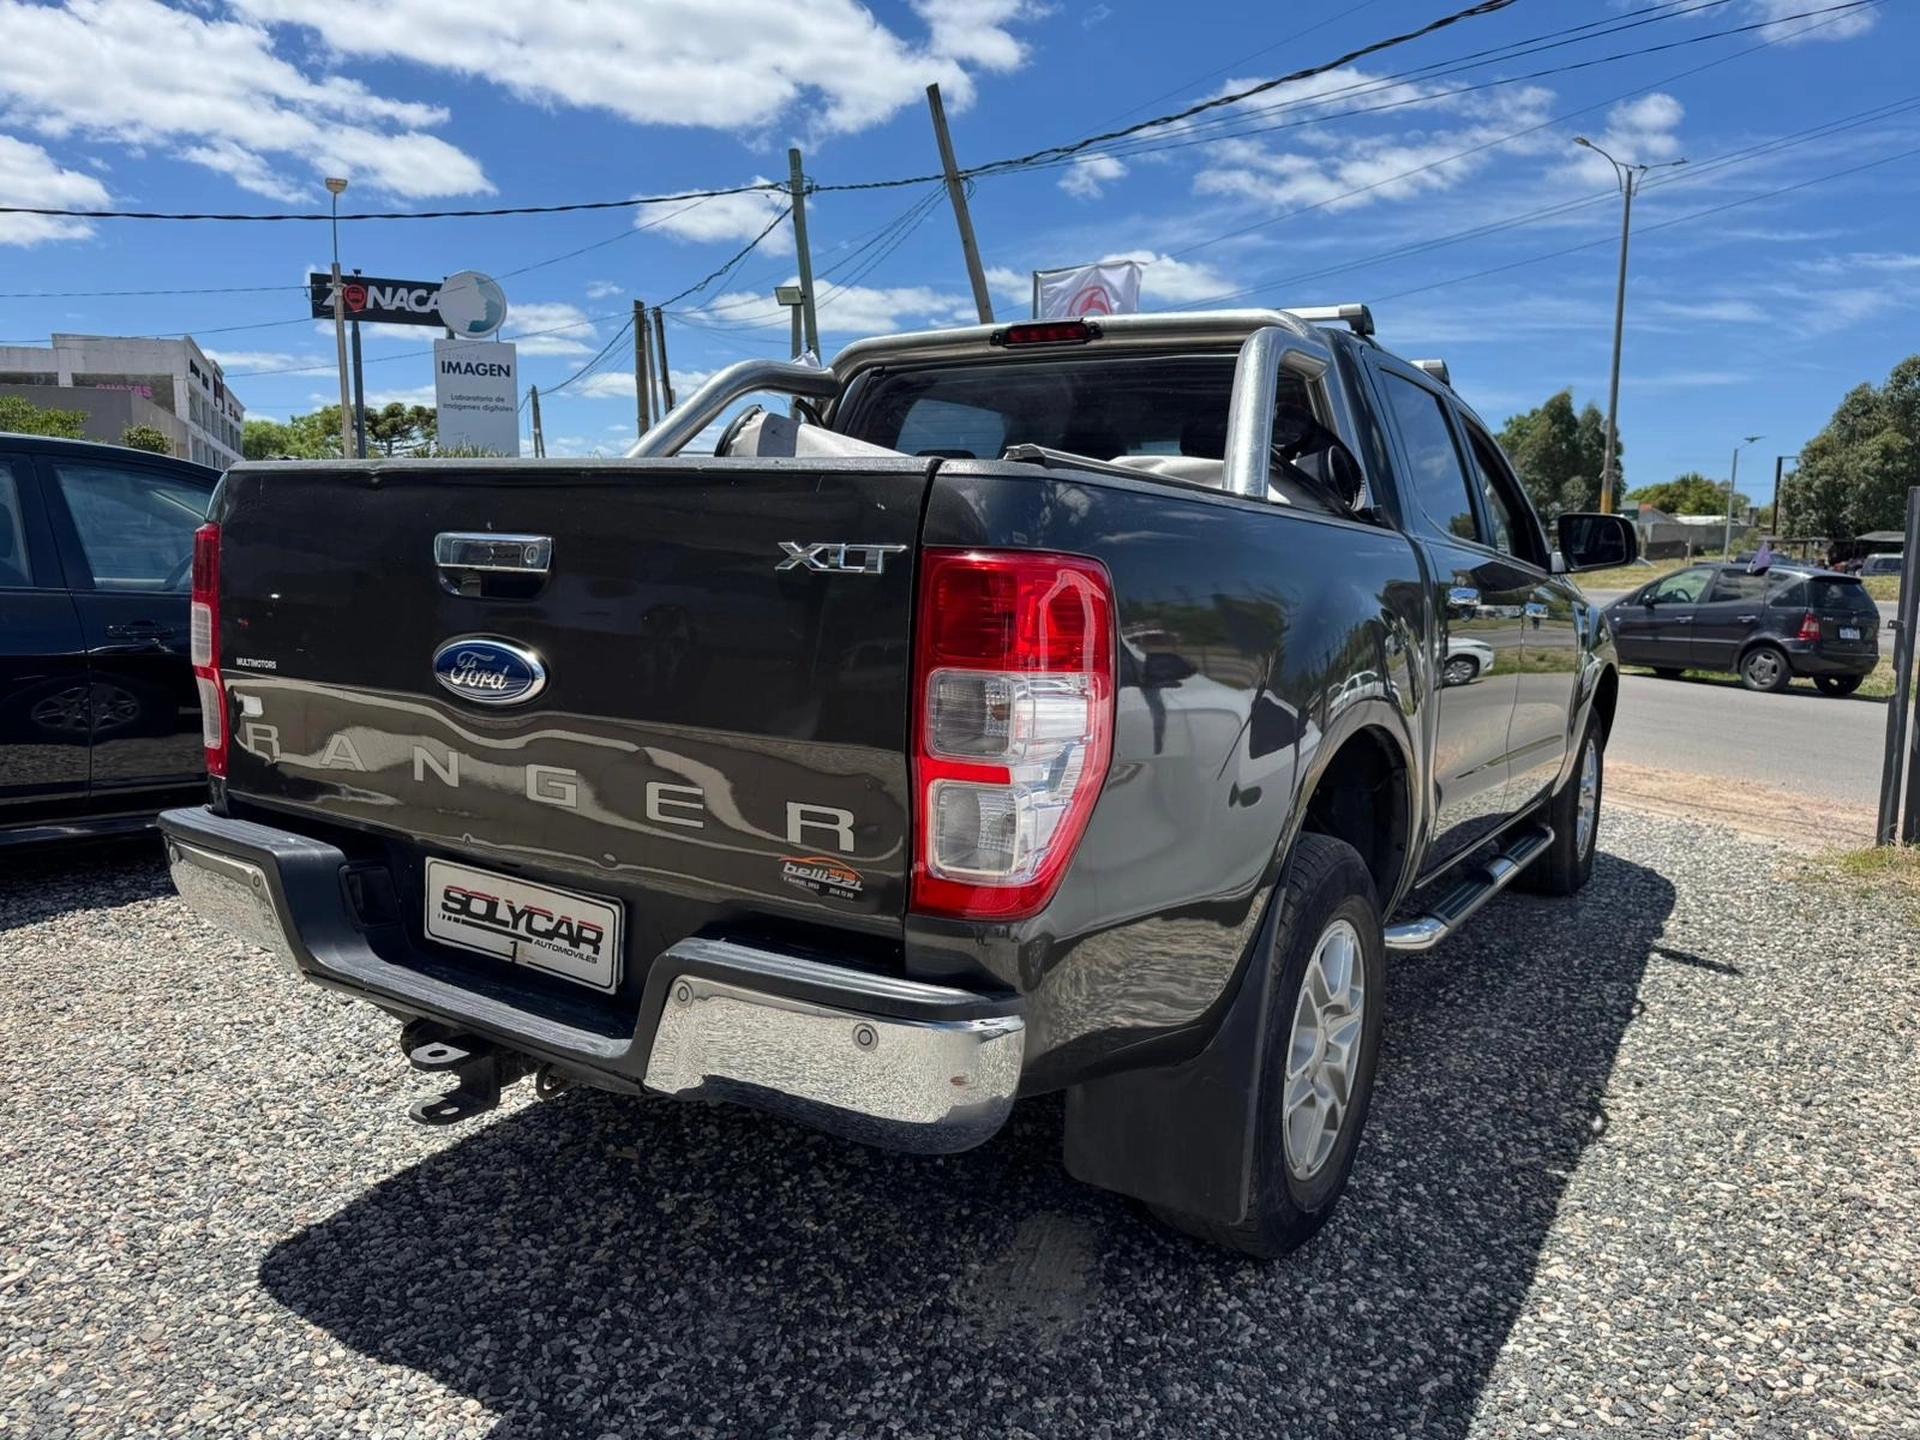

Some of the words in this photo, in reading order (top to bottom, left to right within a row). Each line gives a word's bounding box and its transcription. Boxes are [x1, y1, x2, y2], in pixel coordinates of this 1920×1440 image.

[441, 360, 511, 378] IMAGEN
[450, 393, 494, 402] Laboratorio
[482, 404, 513, 412] digitales
[774, 541, 908, 574] XLT
[450, 650, 509, 690] Ford
[245, 721, 855, 852] RANGER
[441, 884, 604, 956] SOLYCAR
[534, 938, 598, 965] AUTOMOVILES
